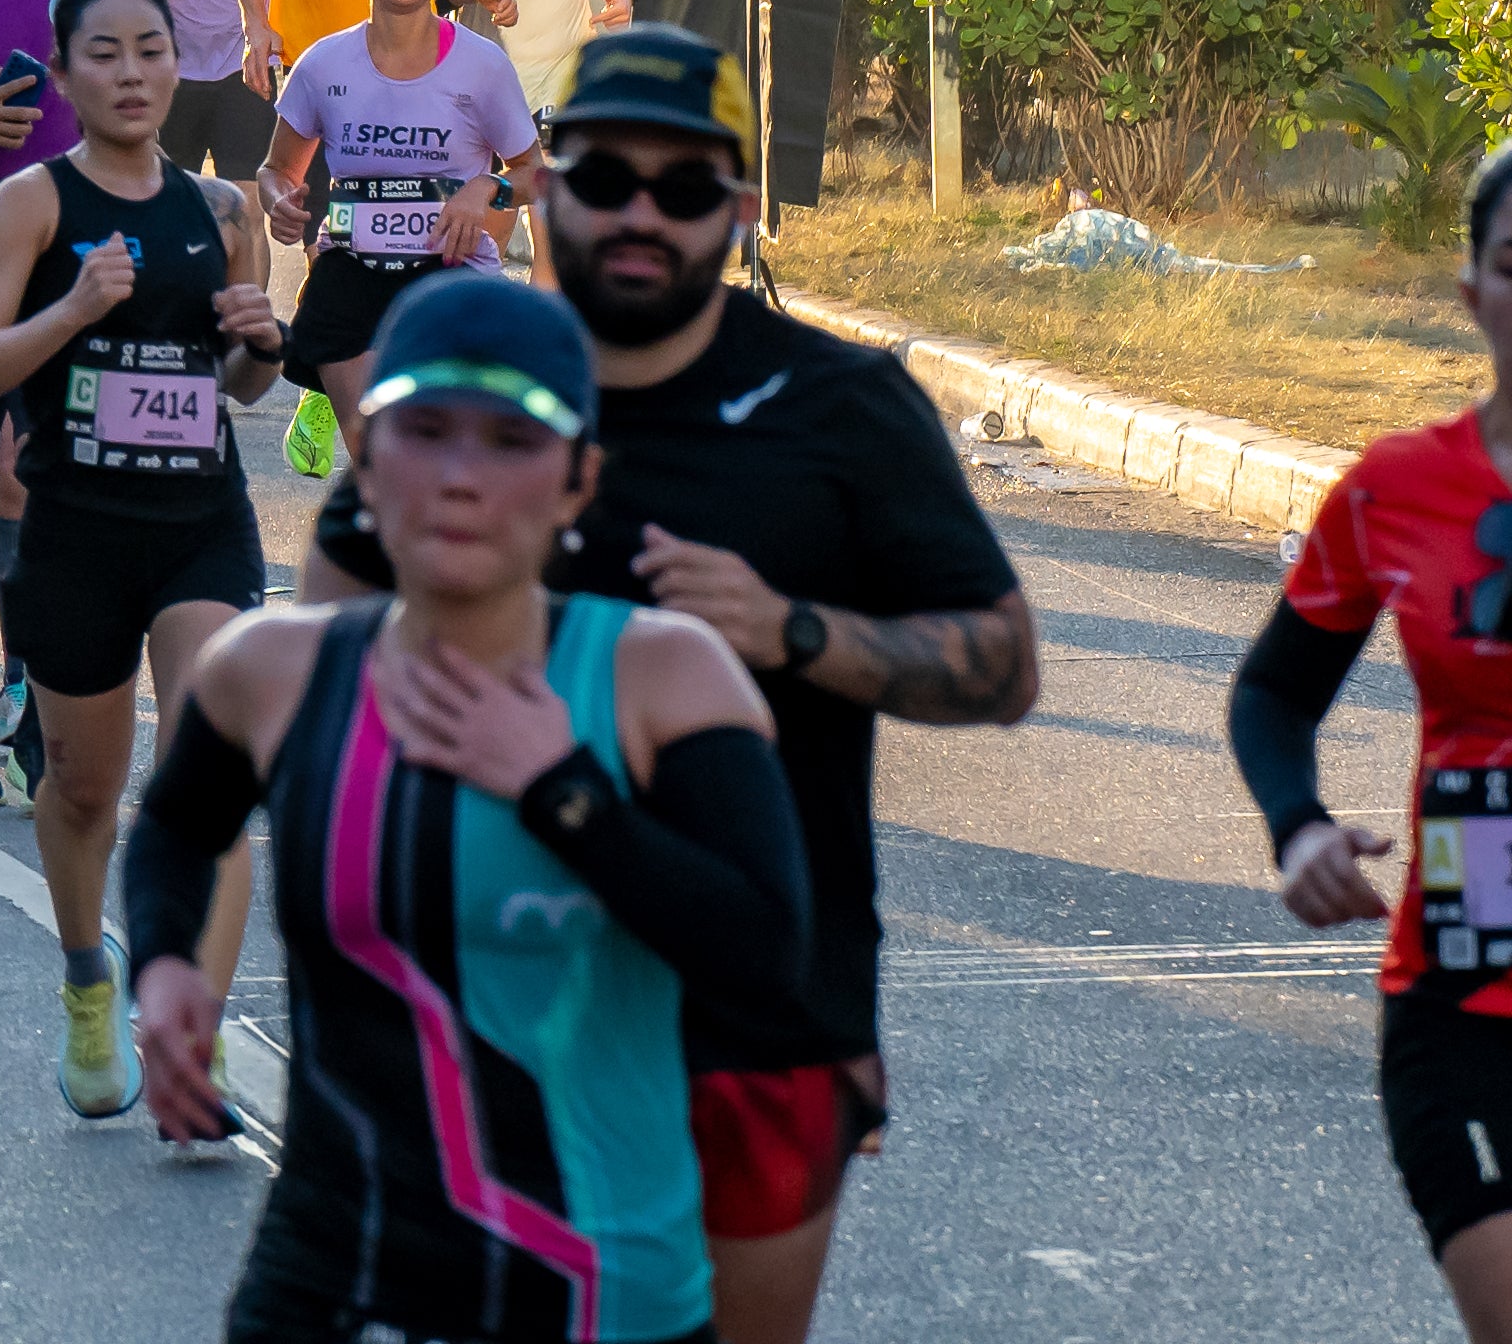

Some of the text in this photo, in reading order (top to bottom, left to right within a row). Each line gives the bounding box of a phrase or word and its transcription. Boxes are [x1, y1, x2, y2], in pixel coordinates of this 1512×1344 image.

[327, 84, 348, 98] nu
[357, 123, 453, 149] SPCITY
[340, 145, 450, 162] HALF MARATHON
[381, 179, 422, 191] SPCITY
[335, 209, 350, 228] C
[138, 343, 186, 361] SPCITY
[128, 386, 199, 422] 7414
